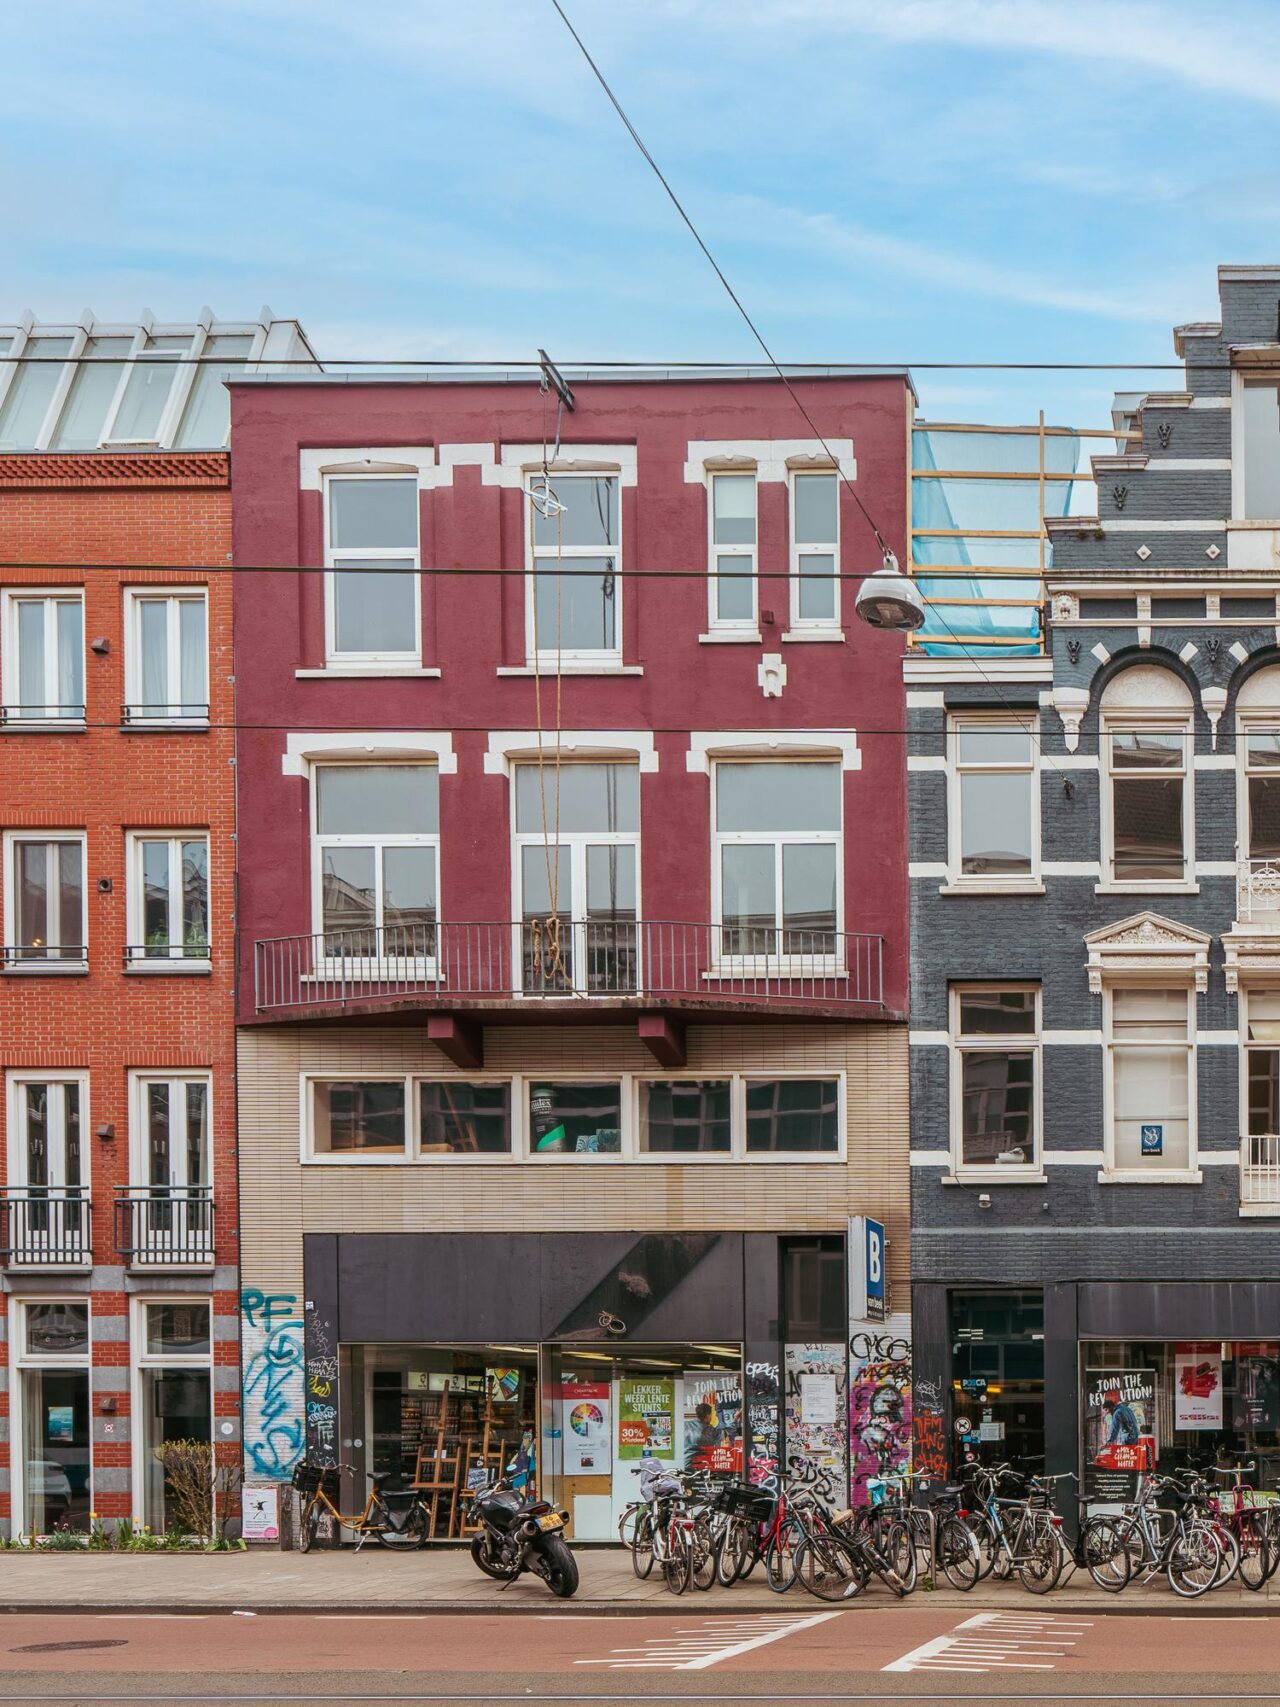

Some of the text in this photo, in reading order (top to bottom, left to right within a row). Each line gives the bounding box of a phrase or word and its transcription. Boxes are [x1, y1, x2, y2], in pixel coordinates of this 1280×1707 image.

[869, 1230, 880, 1283] B
[874, 1296, 883, 1310] beek
[694, 1376, 738, 1394] JOIN THE
[963, 1379, 986, 1387] POSCA
[1097, 1373, 1142, 1393] JOIN THE
[632, 1385, 661, 1394] LEKKER
[624, 1394, 670, 1403] WEER LENTE
[632, 1403, 661, 1413] STUNTS
[622, 1428, 644, 1438] 30%
